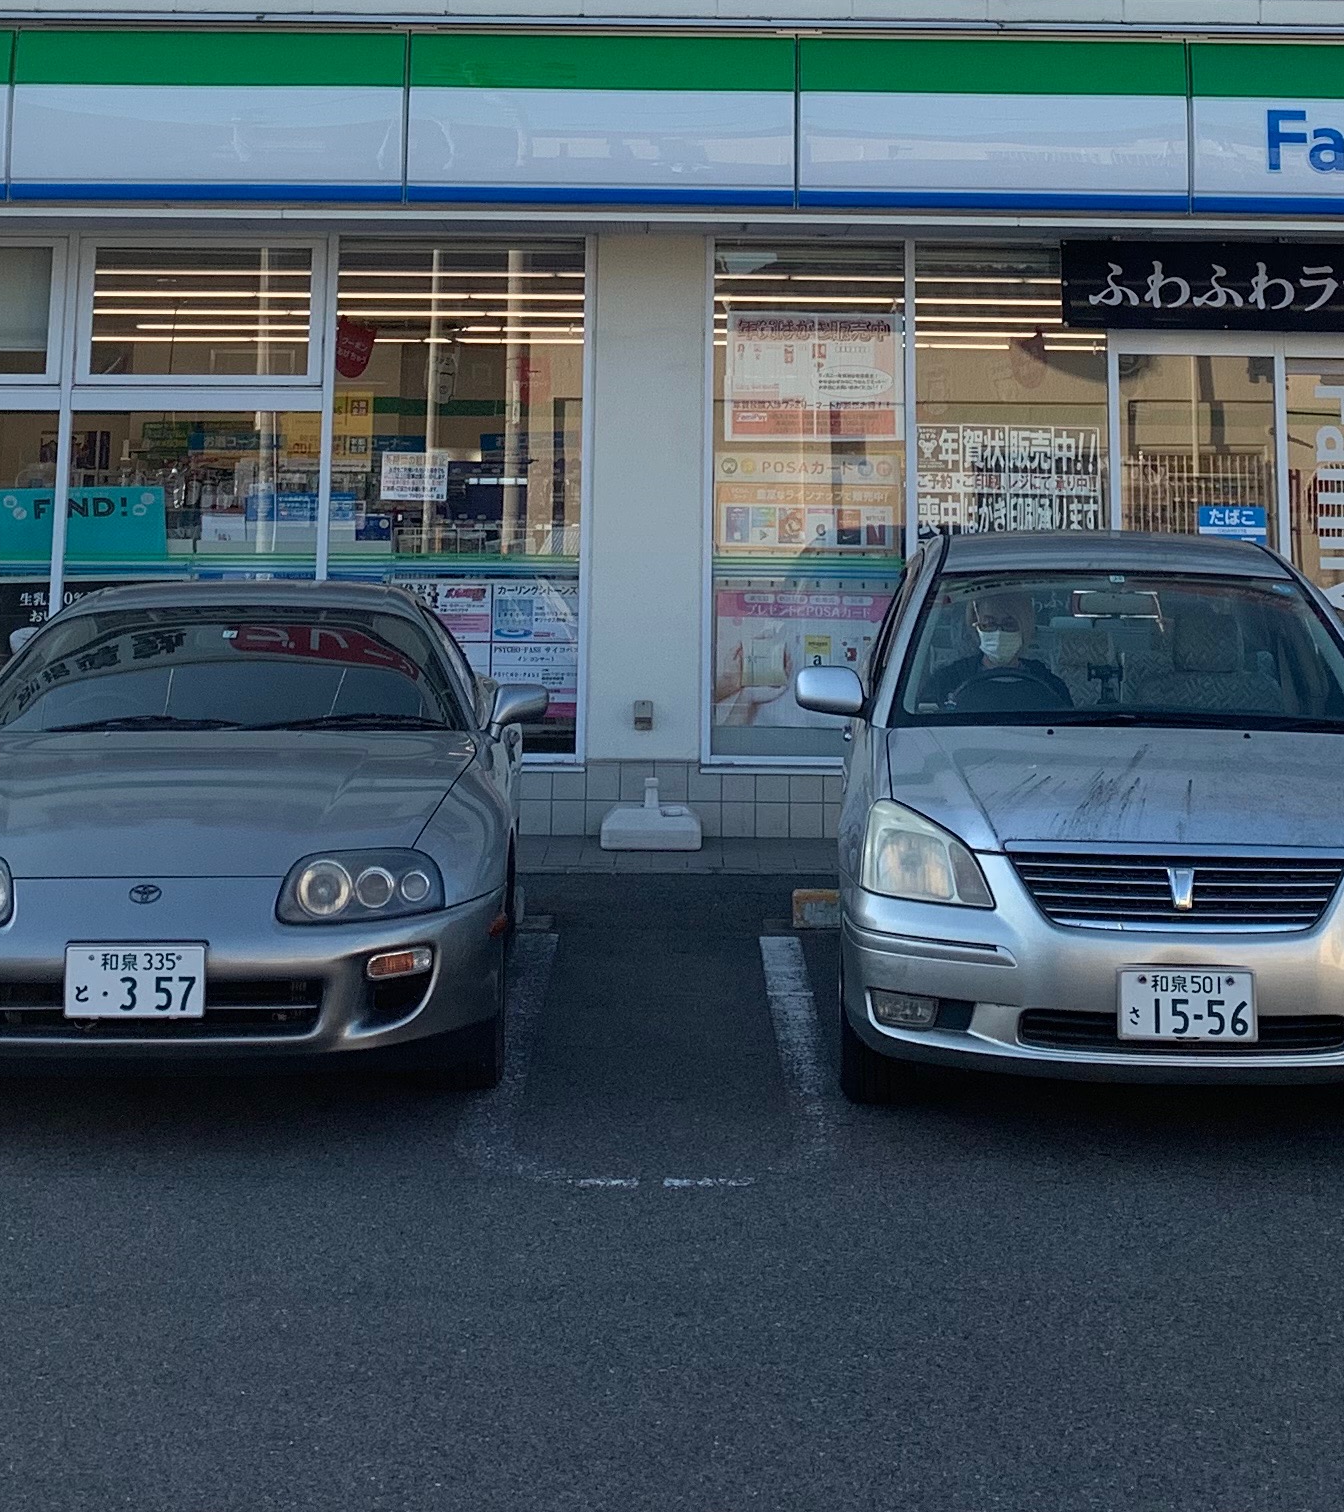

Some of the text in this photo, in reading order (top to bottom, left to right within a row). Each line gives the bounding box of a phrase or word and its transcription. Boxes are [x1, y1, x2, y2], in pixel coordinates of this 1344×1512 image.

[938, 428, 1096, 473] 年賀状販売中!!
[33, 496, 128, 519] FND!
[1209, 508, 1256, 526] たばこ
[101, 953, 176, 971] 和泉 335
[75, 985, 89, 1002] と
[1150, 975, 1221, 994] 和泉 501
[1129, 998, 1249, 1036] さ 15-56
